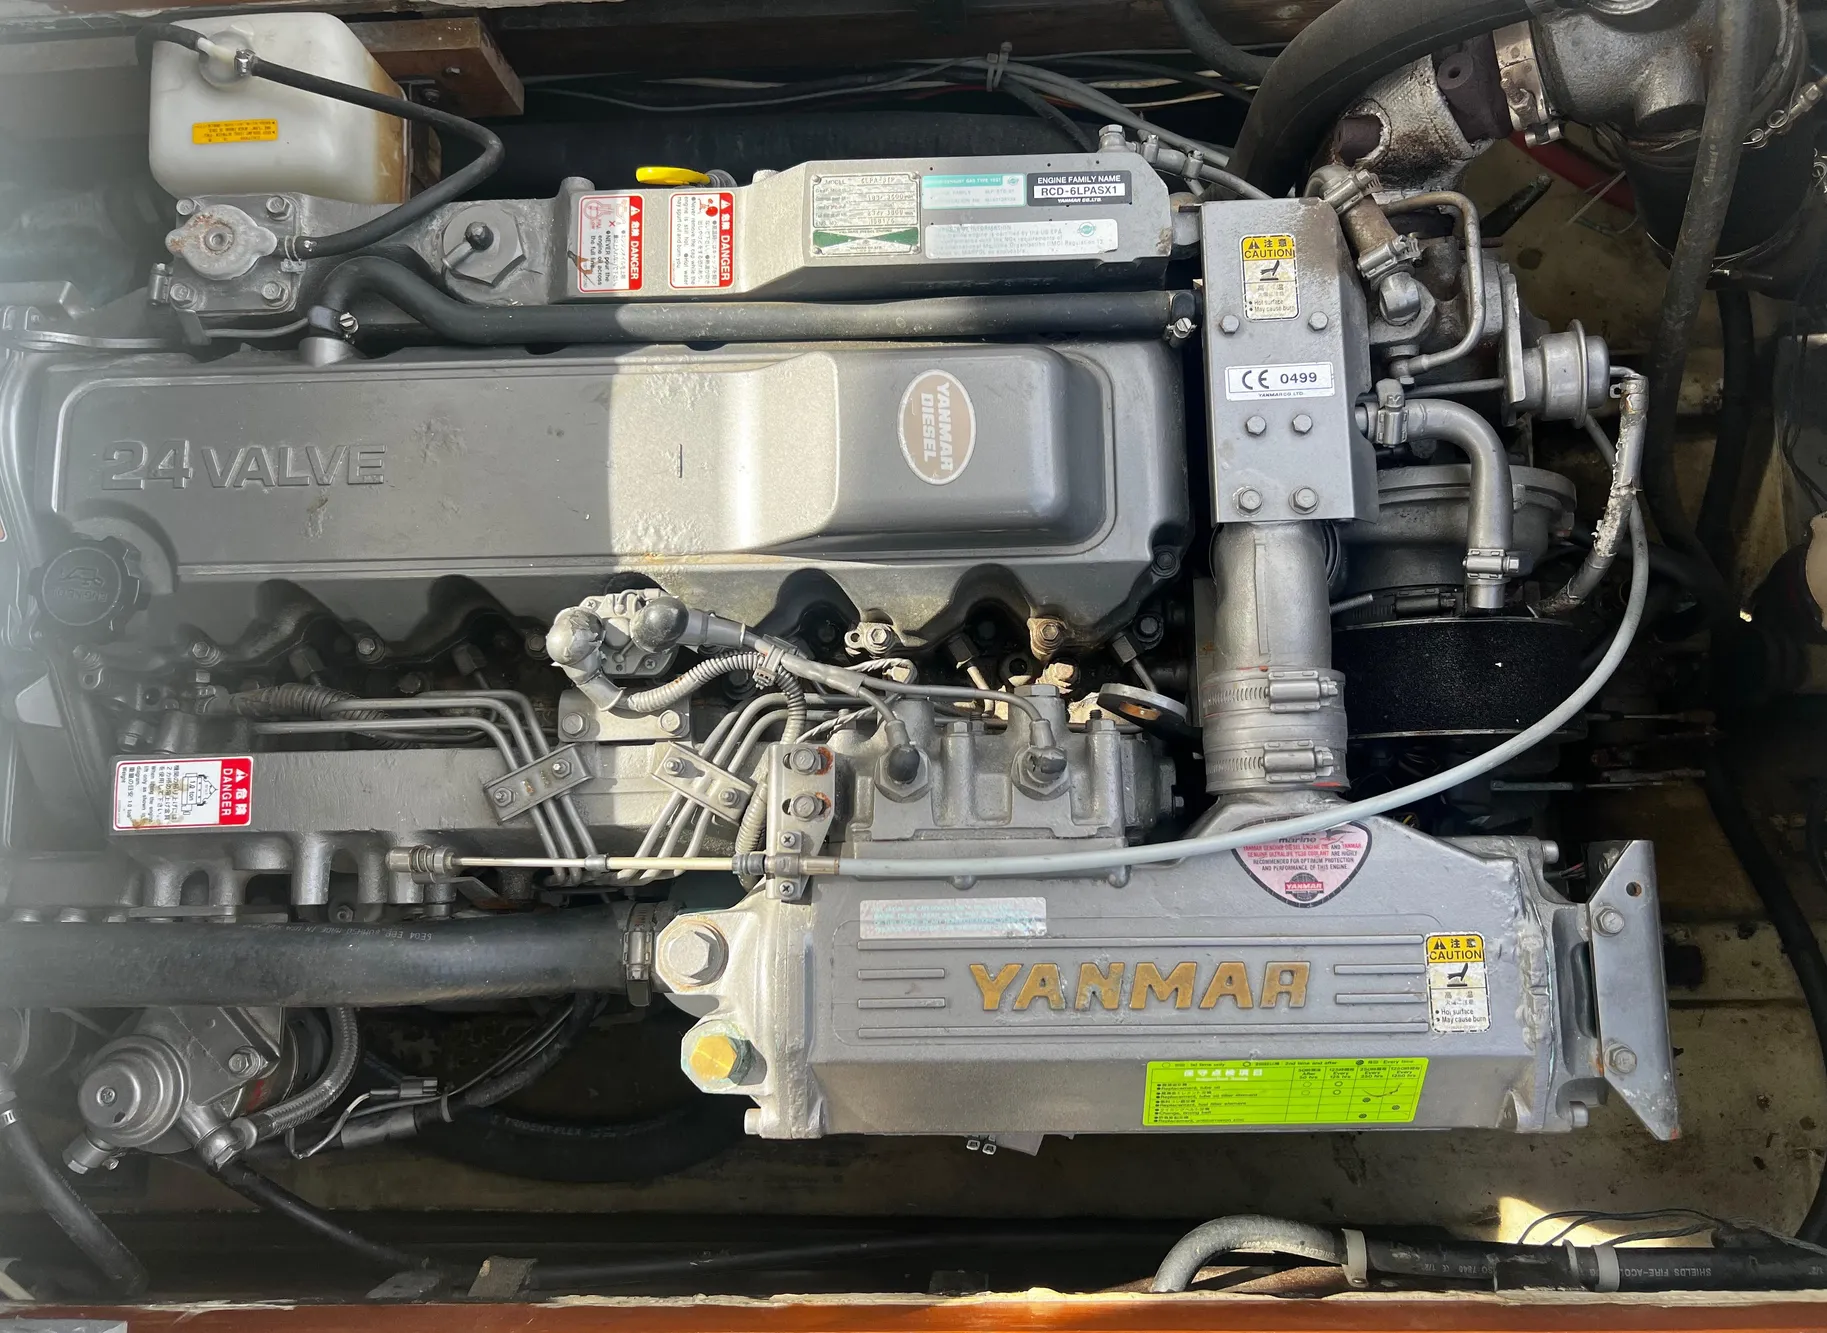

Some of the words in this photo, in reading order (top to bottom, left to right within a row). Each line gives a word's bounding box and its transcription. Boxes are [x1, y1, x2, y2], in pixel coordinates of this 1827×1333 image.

[1041, 186, 1117, 196] RCD-6LPASX1
[1264, 239, 1287, 247] 注意
[721, 236, 730, 280] DANGER
[1244, 249, 1292, 259] CAUTION
[1280, 372, 1317, 384] 0499
[921, 392, 937, 463] DIESEL
[937, 382, 953, 471] YANMAR
[101, 439, 193, 491] 24
[202, 444, 387, 488] VALVE
[67, 589, 108, 602] ENGINE
[188, 792, 196, 801] ton
[221, 768, 233, 816] DANGER
[235, 788, 248, 815] 危険
[320, 926, 342, 934] MADE
[1429, 950, 1482, 960] CAUTION
[969, 960, 1310, 1012] YANMAR
[1442, 1016, 1454, 1024] May
[1304, 1247, 1335, 1259] SHIELDS
[1673, 1268, 1712, 1277] SHIELDS
